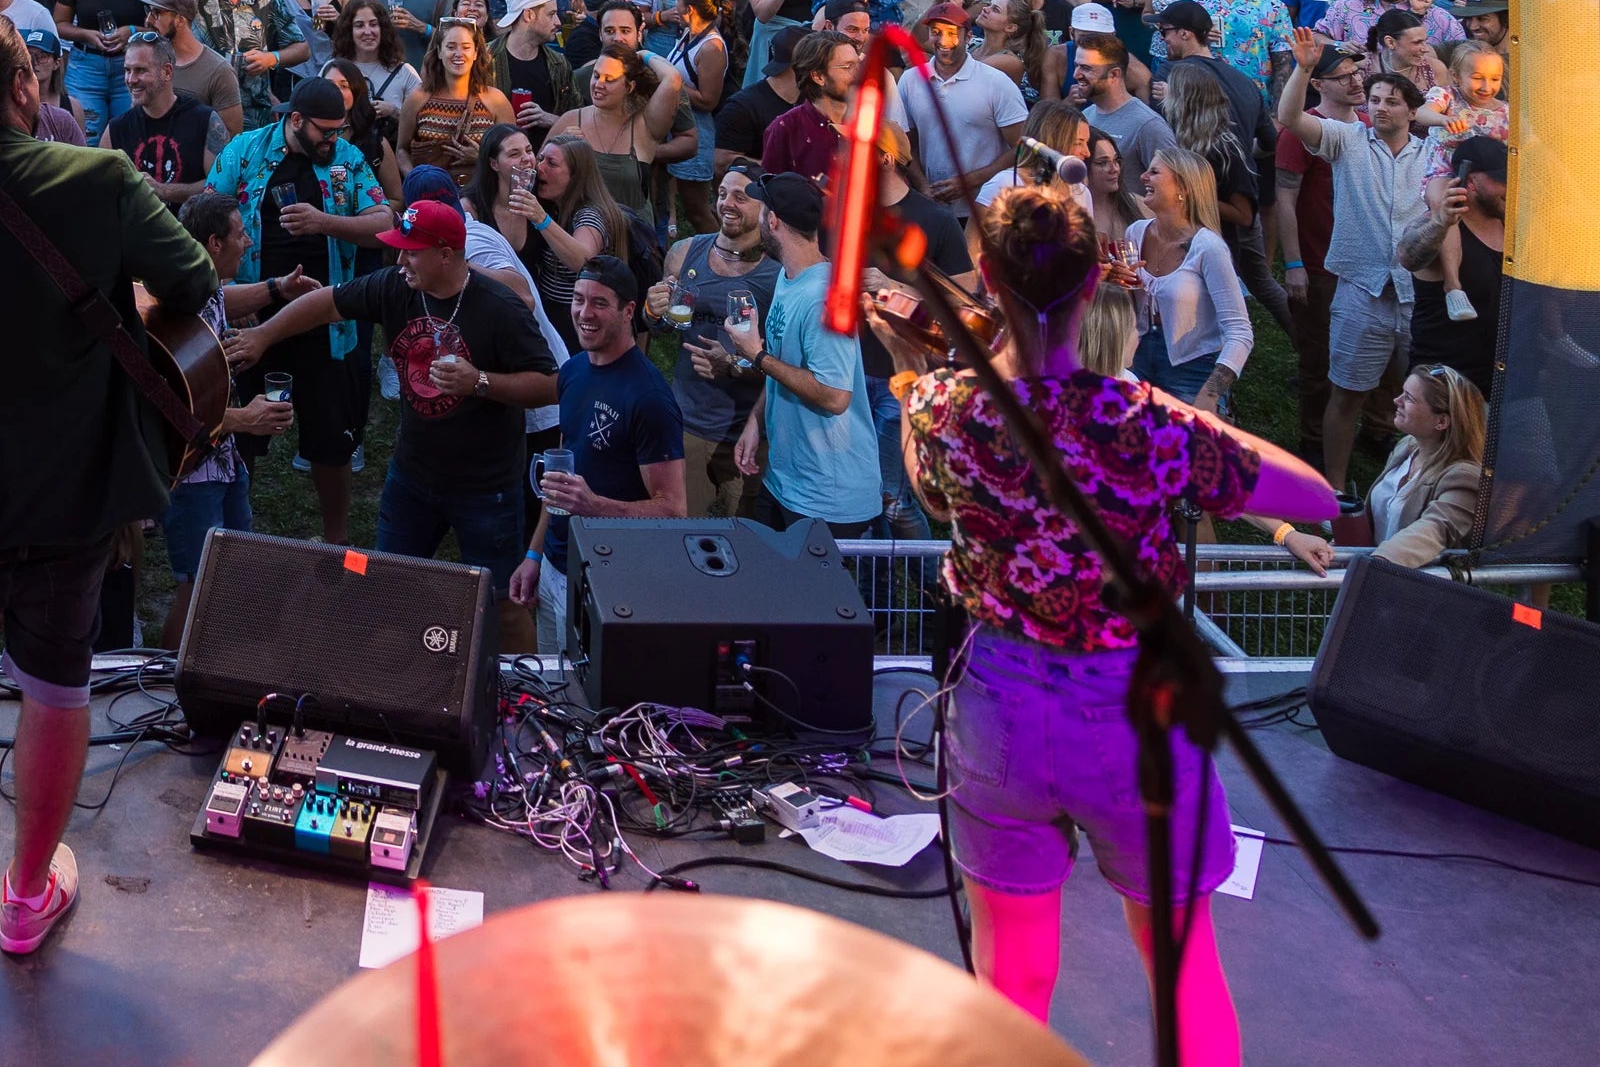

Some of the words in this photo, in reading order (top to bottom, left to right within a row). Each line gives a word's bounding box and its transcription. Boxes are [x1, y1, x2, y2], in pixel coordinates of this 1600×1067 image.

[594, 401, 620, 421] HAWAII
[449, 630, 459, 653] YAMAHA
[345, 738, 356, 747] la
[358, 741, 422, 760] grand-messe
[264, 804, 283, 814] FLINT
